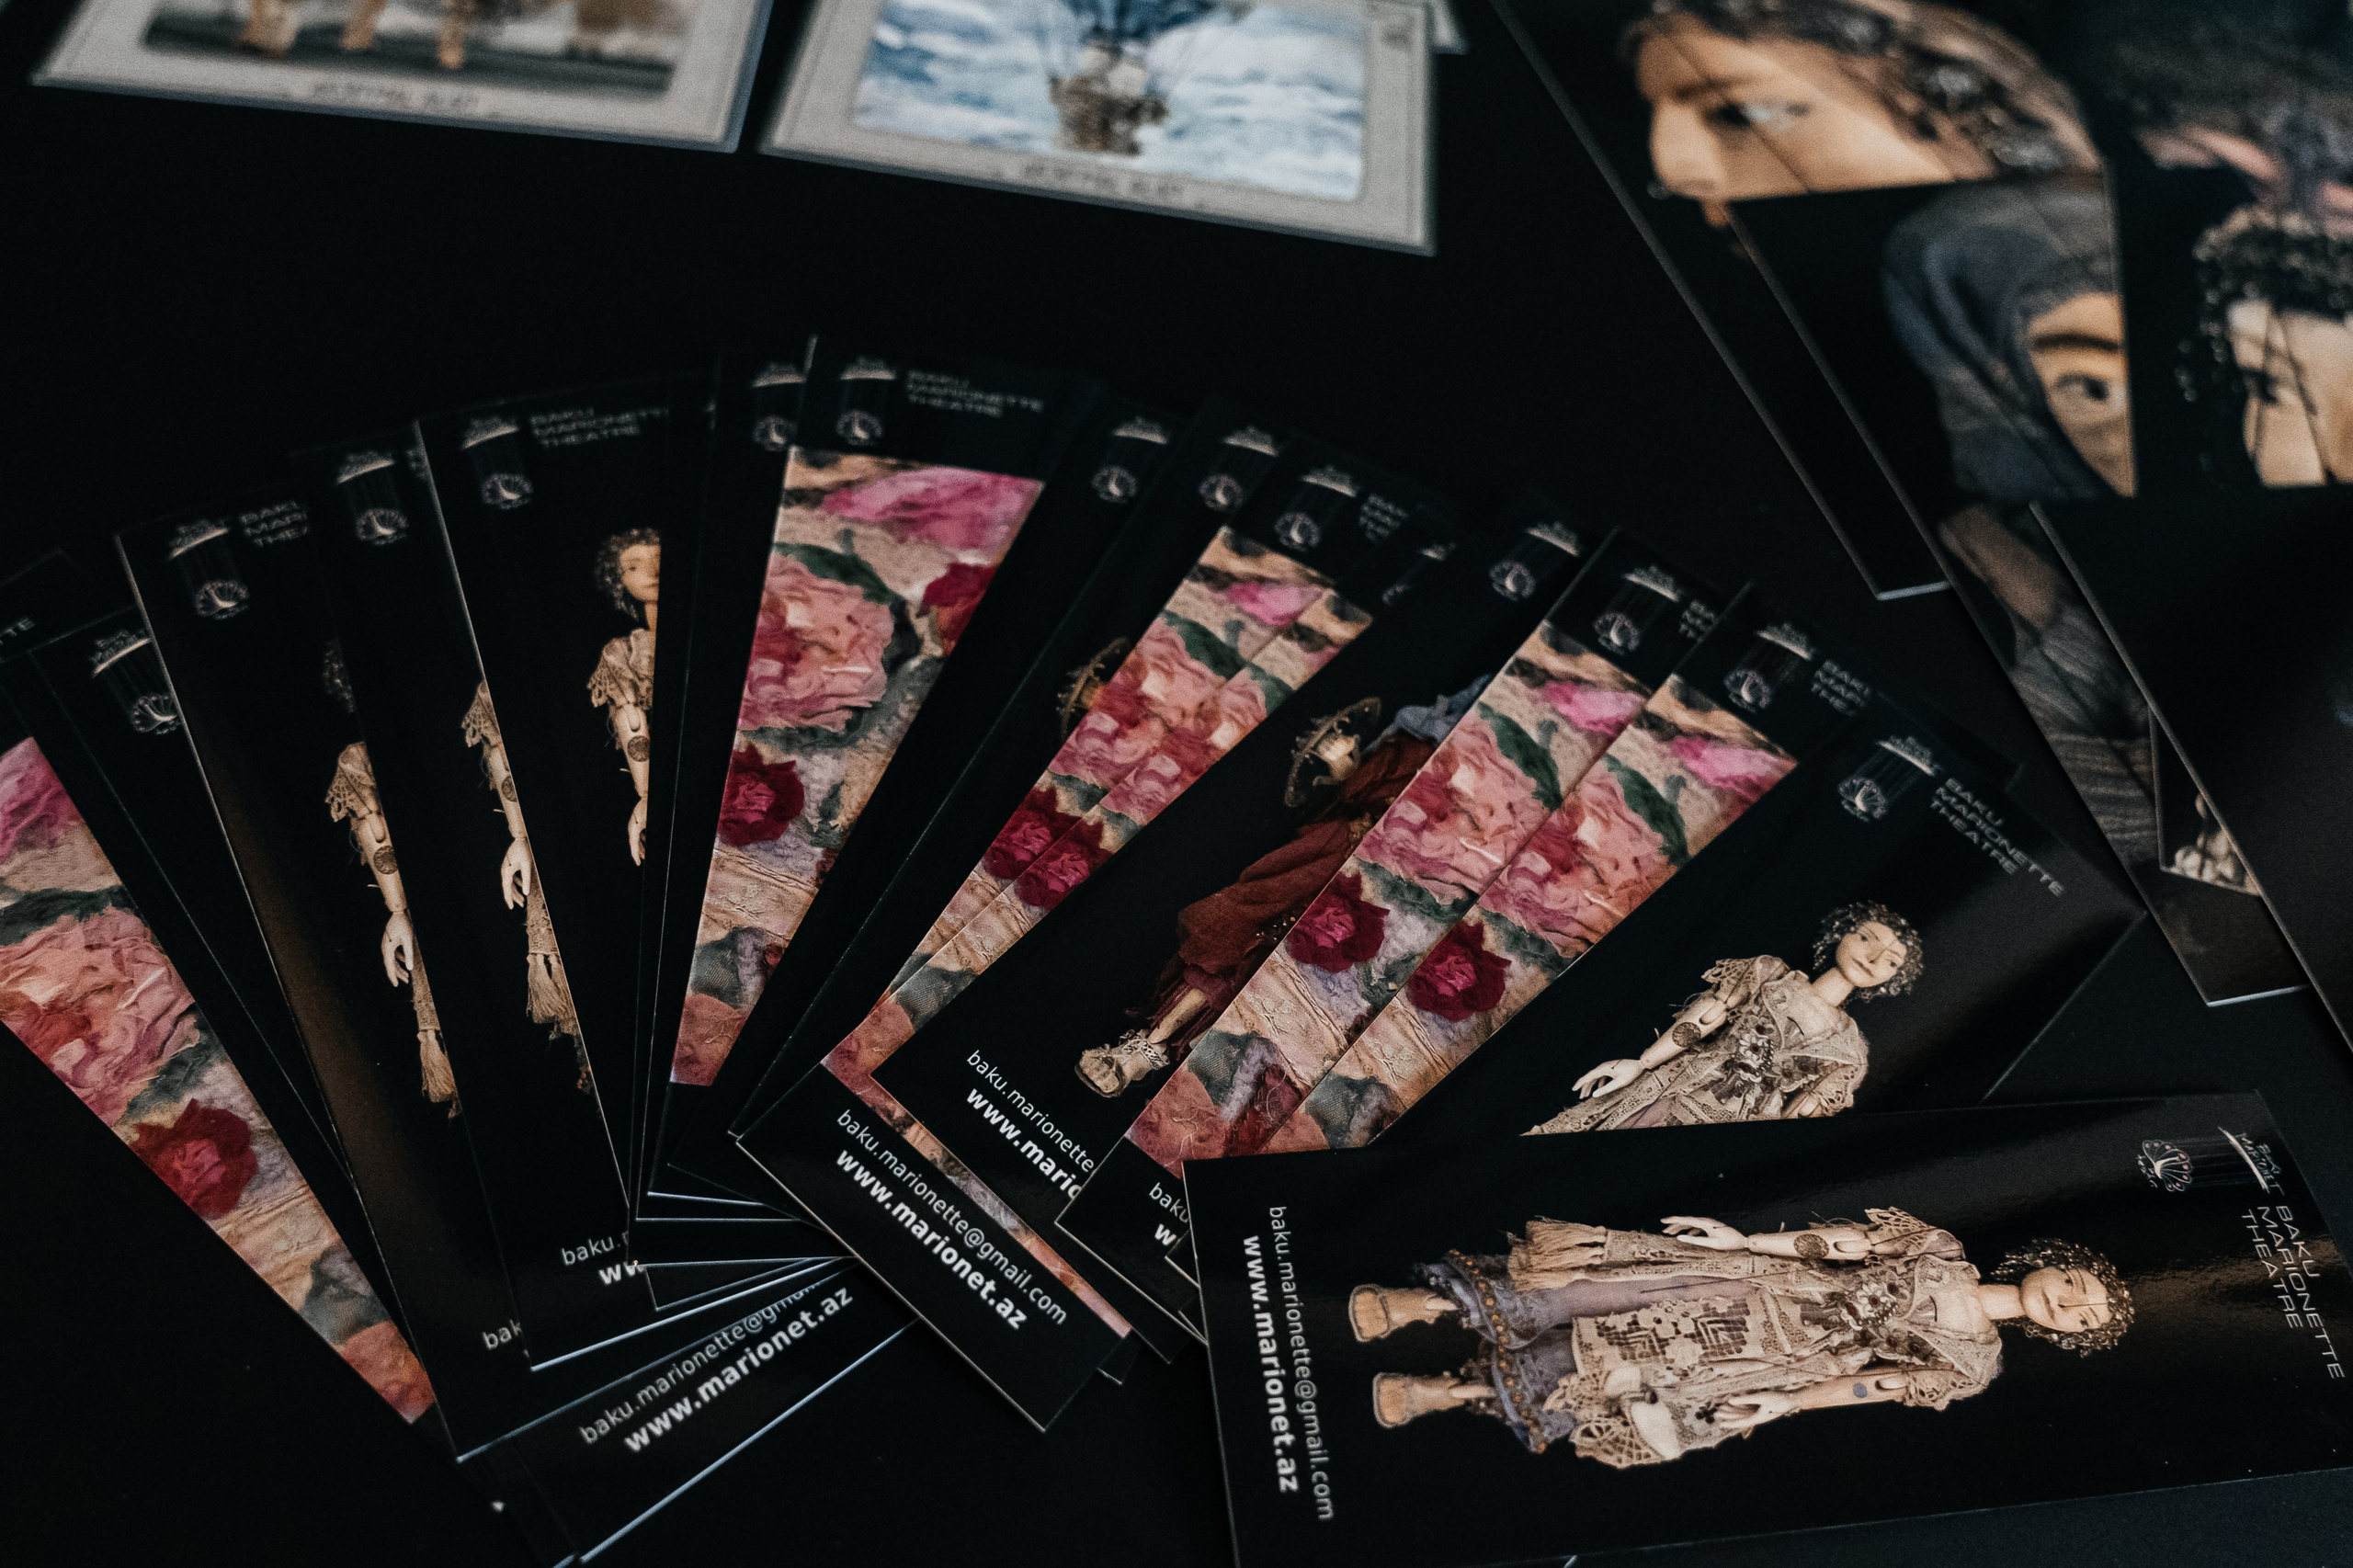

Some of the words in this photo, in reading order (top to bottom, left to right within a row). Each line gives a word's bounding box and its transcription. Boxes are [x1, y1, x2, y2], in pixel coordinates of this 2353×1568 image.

[1929, 797, 2019, 876] THEATRE
[1935, 786, 2064, 897] MARIONETTE
[1945, 778, 2005, 827] BAKU
[835, 1147, 1029, 1331] www.marionet.az
[836, 1108, 1068, 1326] baku.marionette@gmail.com
[1149, 1181, 1189, 1224] baku
[2241, 1209, 2304, 1329] THEATRE
[2275, 1205, 2321, 1278] BAKU
[1243, 1234, 1301, 1494] www.marionet.az
[1269, 1206, 1335, 1521] baku.marionette@gmail.com
[2256, 1206, 2346, 1380] MARIONETTE
[623, 1286, 854, 1453] www.marionet.az
